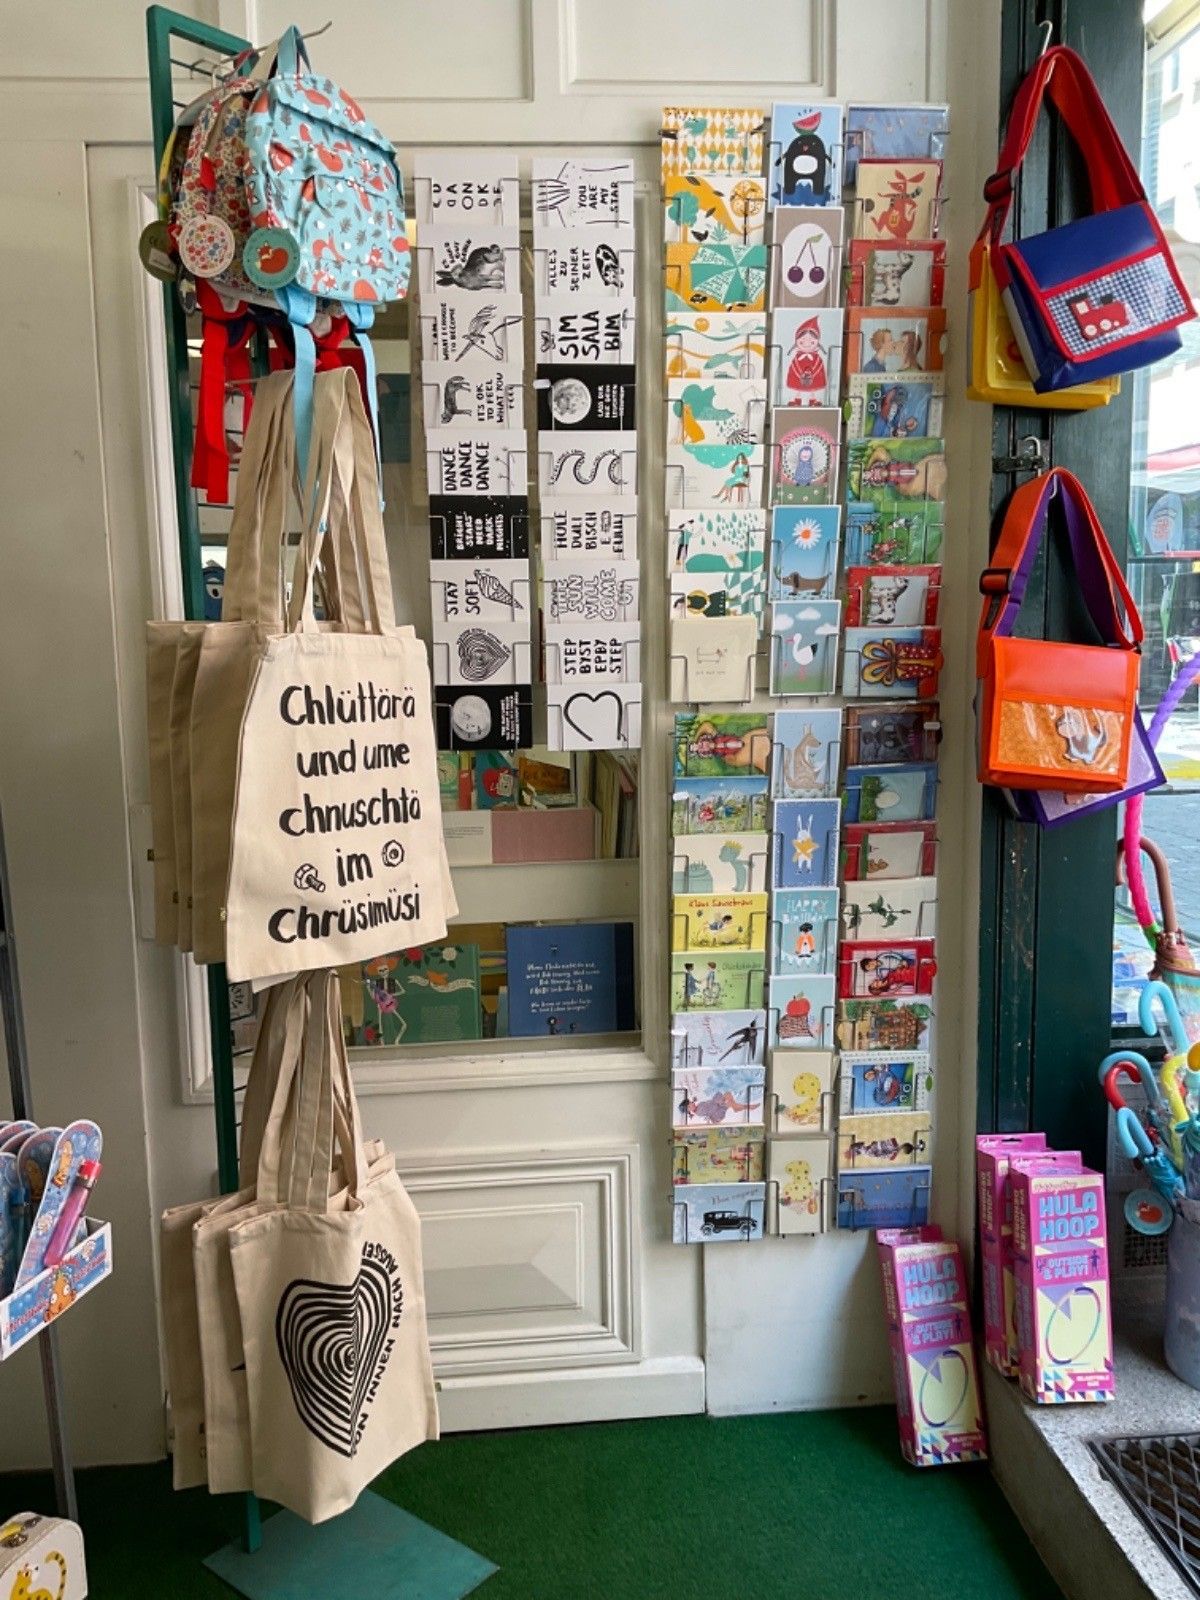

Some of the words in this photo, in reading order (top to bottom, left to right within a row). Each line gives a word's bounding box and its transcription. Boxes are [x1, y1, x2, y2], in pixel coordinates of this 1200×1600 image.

[578, 185, 587, 209] YOU
[588, 184, 598, 210] ARE
[600, 188, 608, 205] MY
[610, 181, 619, 213] STAR
[549, 249, 557, 288] ALLES
[559, 261, 567, 276] ZU
[570, 247, 579, 291] SEINER
[582, 249, 591, 279] ZEIT
[558, 315, 579, 359] SIM
[581, 310, 600, 360] SALA
[604, 313, 621, 351] BIM
[476, 383, 484, 400] OK
[485, 379, 494, 404] FEEL
[496, 372, 504, 391] YOU
[486, 408, 494, 420] TO
[496, 396, 504, 423] WHAT
[442, 447, 457, 492] DANCE
[458, 440, 473, 488] DANCE
[475, 441, 490, 491] DANCE
[465, 514, 474, 548] STARS
[475, 518, 484, 545] NEED
[585, 512, 598, 550] BISCH
[446, 581, 459, 615] STAY
[464, 579, 480, 615] SOFT
[567, 574, 584, 613] SUN
[584, 575, 599, 620] WILL
[599, 568, 616, 621] COME
[564, 638, 577, 675] STEP
[579, 639, 591, 674] BYST
[594, 639, 607, 674] EPBY
[609, 638, 622, 674] STEP
[280, 681, 416, 726] Chlüttärä
[296, 738, 356, 778] und
[363, 742, 411, 771] ume
[336, 848, 373, 887] im
[1040, 1191, 1097, 1217] HULA
[1040, 1214, 1099, 1241] HOOP
[903, 1258, 956, 1286] HULA
[392, 1277, 404, 1328] NACH
[906, 1280, 960, 1309] HOOP
